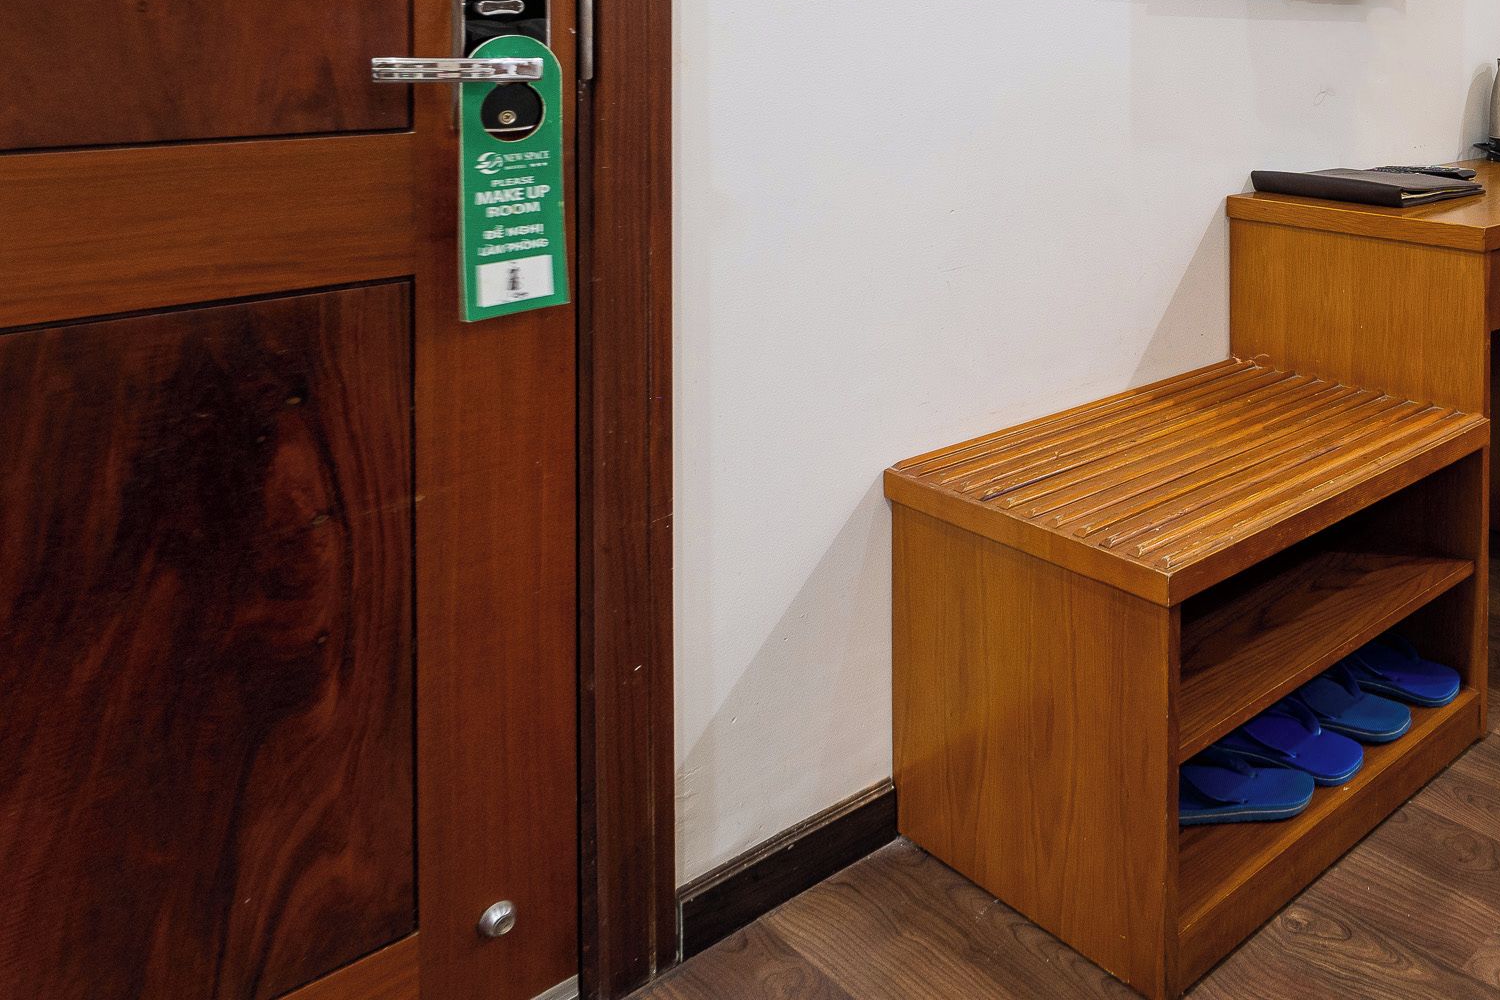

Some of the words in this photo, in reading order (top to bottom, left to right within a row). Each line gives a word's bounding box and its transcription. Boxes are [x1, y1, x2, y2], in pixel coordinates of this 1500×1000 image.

[491, 176, 535, 187] PLEASE
[474, 187, 525, 206] MAKE
[525, 184, 551, 199] UP
[485, 201, 541, 218] ROOM
